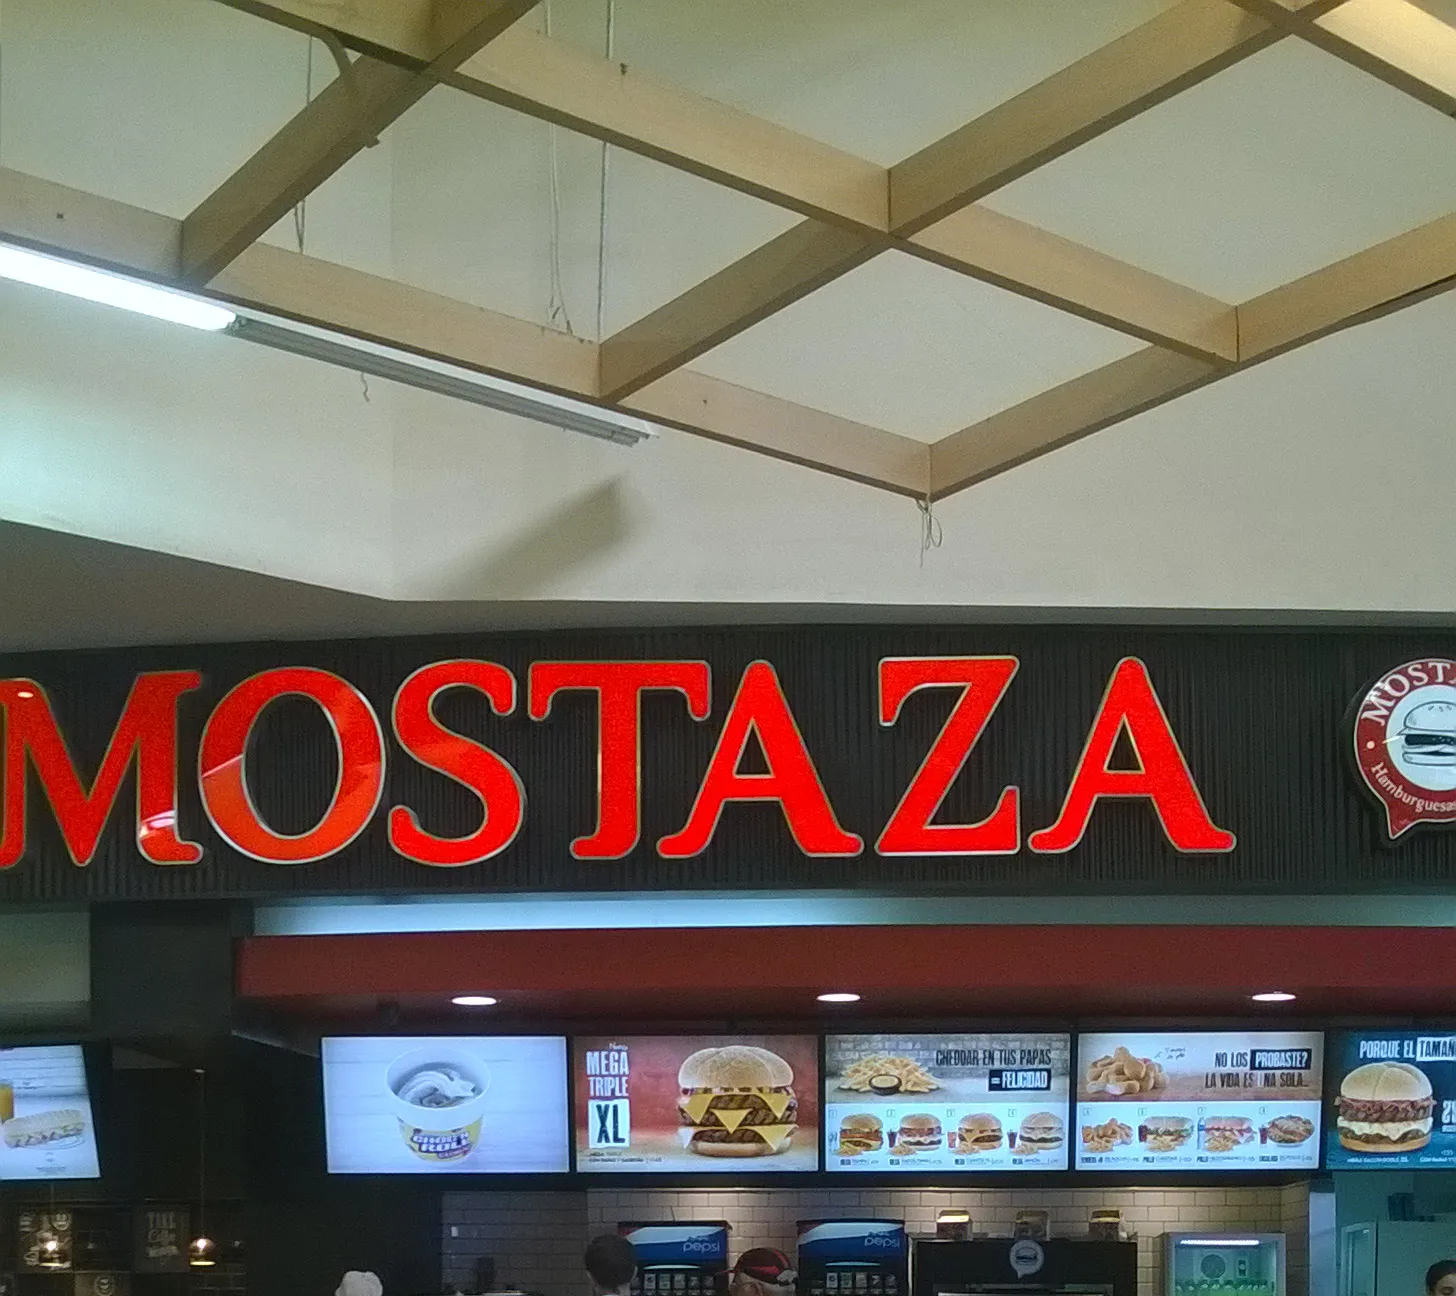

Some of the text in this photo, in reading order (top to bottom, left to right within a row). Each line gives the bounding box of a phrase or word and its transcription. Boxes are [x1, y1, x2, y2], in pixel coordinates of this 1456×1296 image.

[0, 656, 1237, 869] MOSTAZA
[936, 1049, 1051, 1066] CHEDDAR EN TUS PAPAS
[1360, 1041, 1400, 1058] PORQUE
[1403, 1041, 1416, 1058] EL
[586, 1051, 630, 1075] MEGA
[1214, 1051, 1308, 1068] NO LOS PROBASTE?
[588, 1077, 629, 1096] TRIPLE
[1001, 1071, 1048, 1088] FELICIDAD
[1205, 1072, 1217, 1088] LA
[1220, 1072, 1240, 1088] VIDA
[1243, 1072, 1253, 1088] ES
[596, 1104, 626, 1143] XL
[683, 1242, 720, 1254] pepsi
[864, 1236, 901, 1248] pepsi
